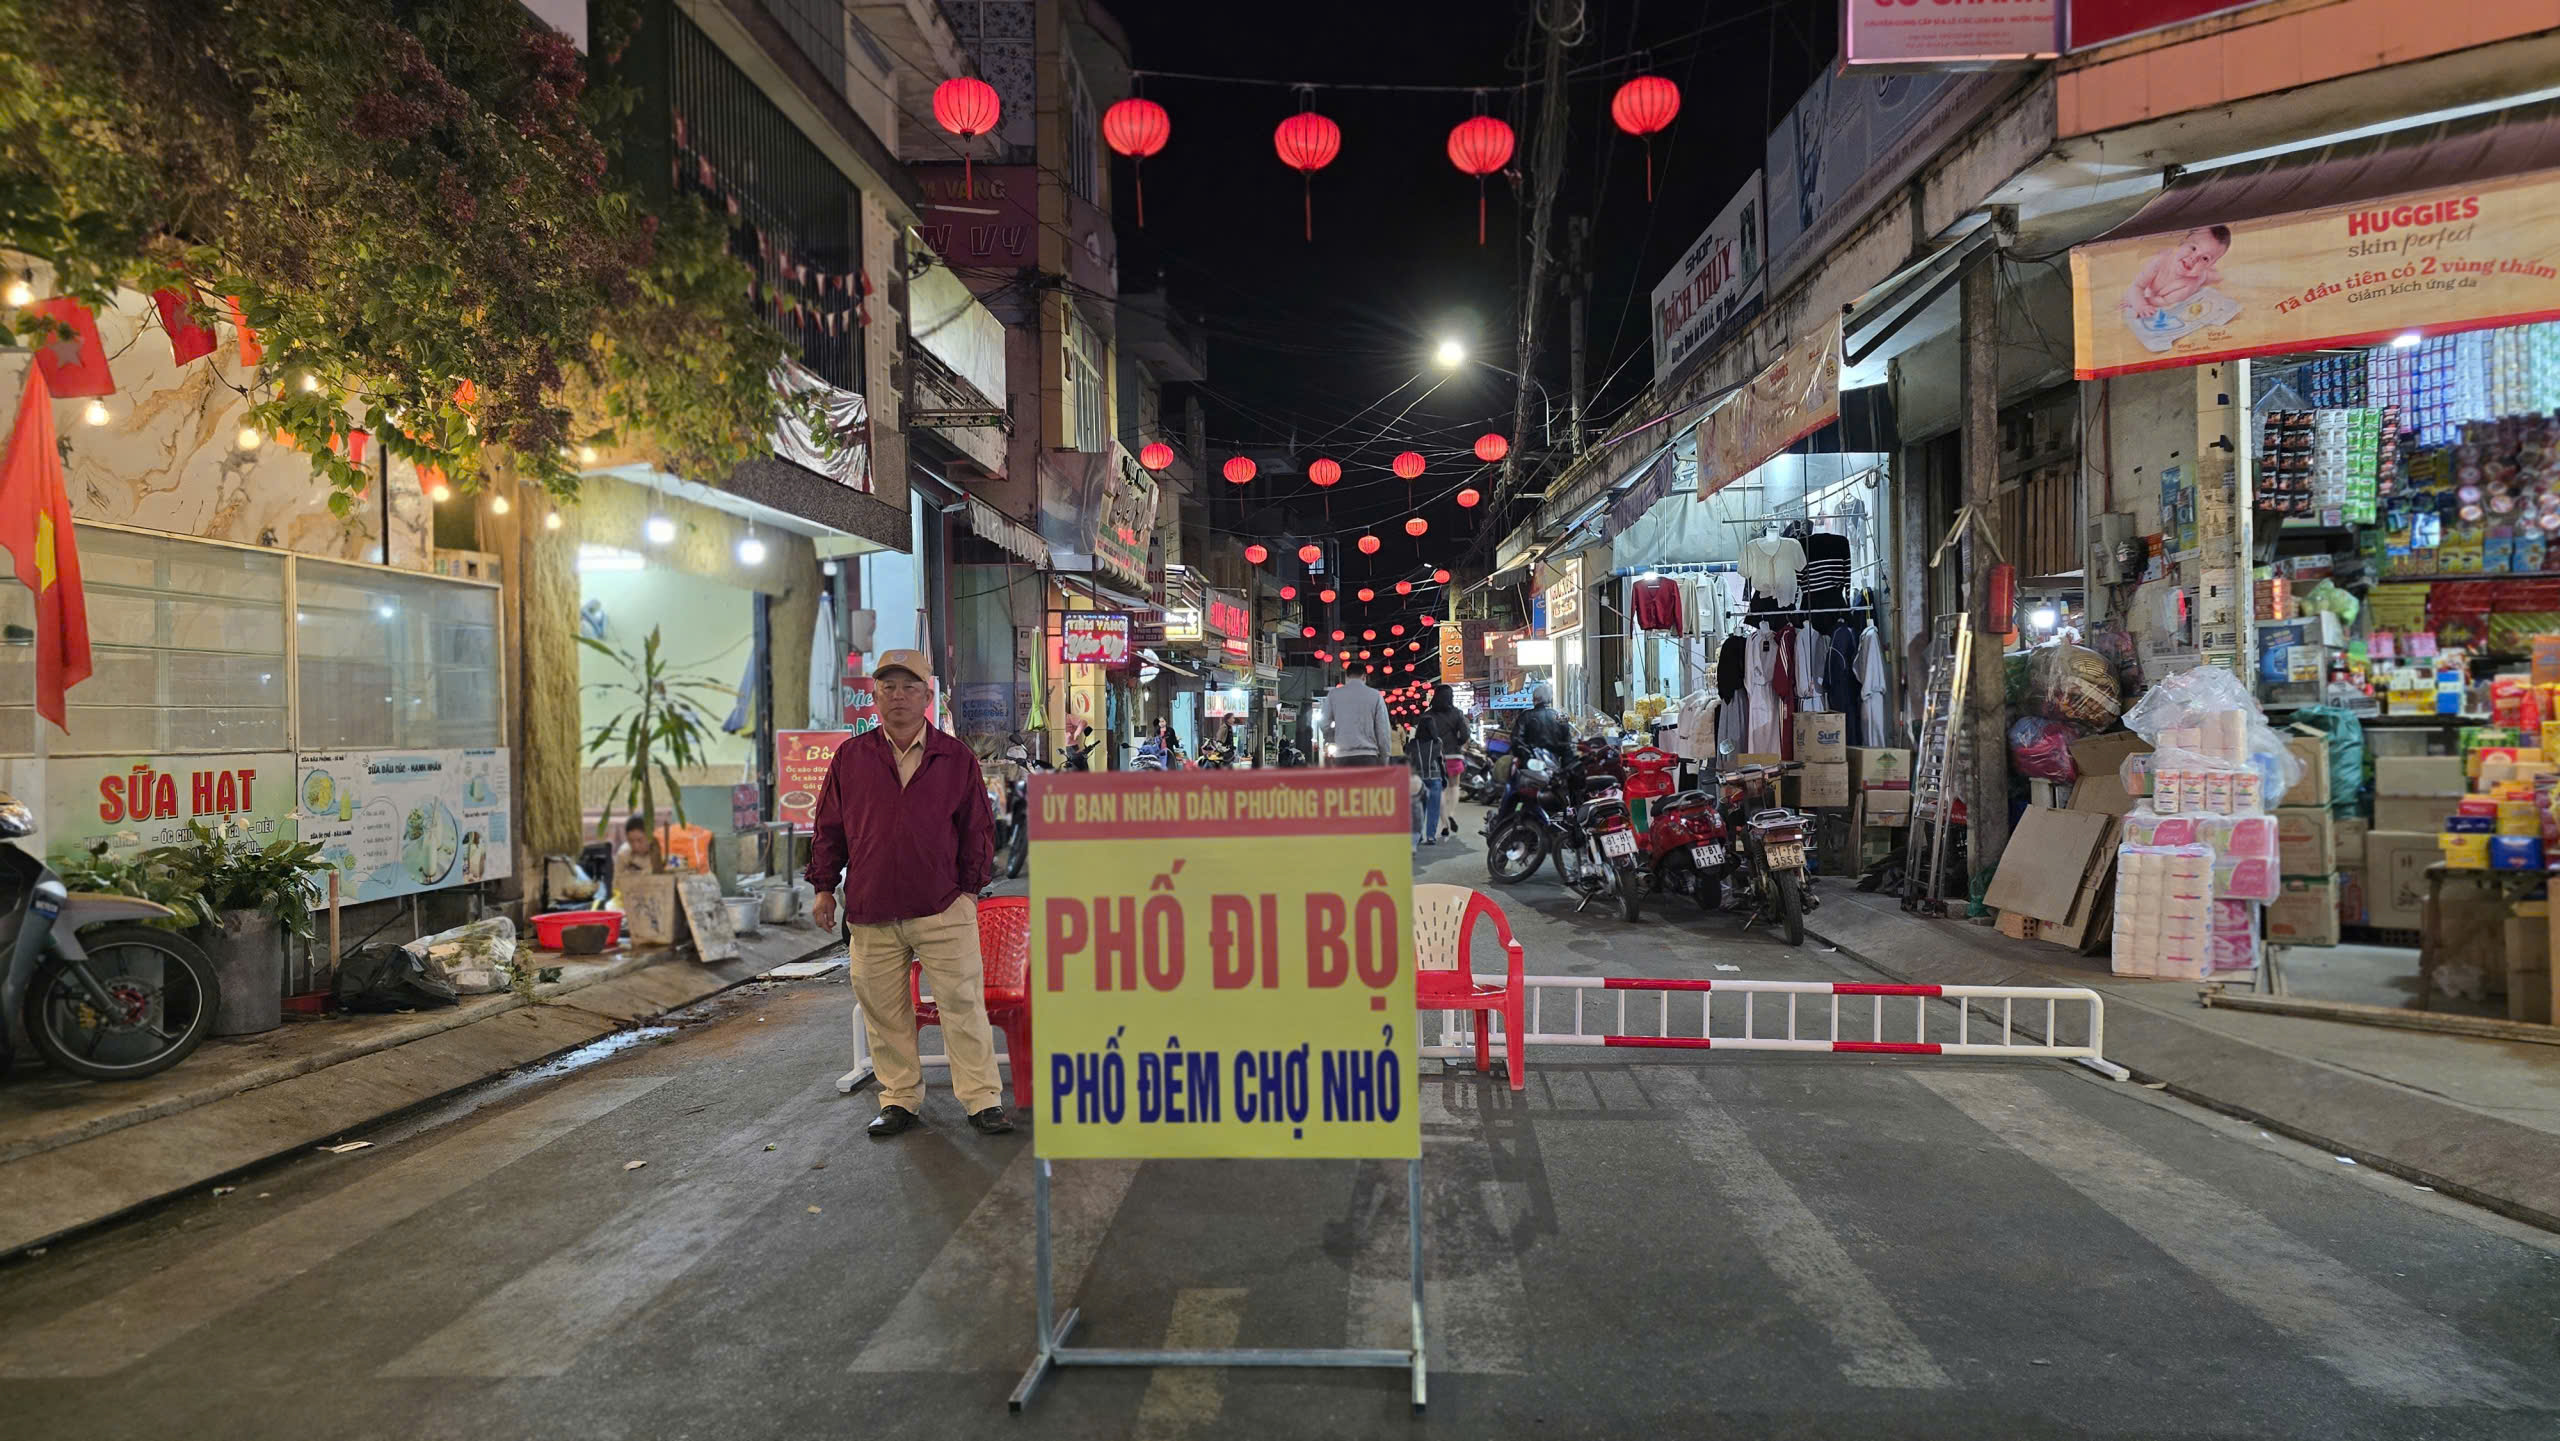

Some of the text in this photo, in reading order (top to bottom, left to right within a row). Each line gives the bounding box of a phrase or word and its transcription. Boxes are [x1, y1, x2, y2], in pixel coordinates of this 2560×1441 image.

[2347, 196, 2480, 237] HUGGIES
[1685, 233, 1713, 276] SHOP
[2347, 222, 2475, 259] skin perfect
[2275, 256, 2557, 315] Tã đầu tiên có 2 vùng thấm
[2347, 276, 2478, 305] Giảm kích ứng da
[1663, 289, 1696, 340] BÍCH
[1817, 730, 1841, 741] Surf
[368, 764, 380, 775] SỮA
[99, 764, 256, 824] SỮA HẠT
[1042, 782, 1395, 824] ỦY BAN NHÂN DÂN PHƯỜNG PLEIKU
[1695, 845, 1718, 858] 81-B1
[1696, 855, 1724, 868] 012.15
[1045, 859, 1399, 1011] PHỐ ĐI BỘ
[1051, 1024, 1401, 1139] PHỐ ĐÊM CHỢ NHỎ
